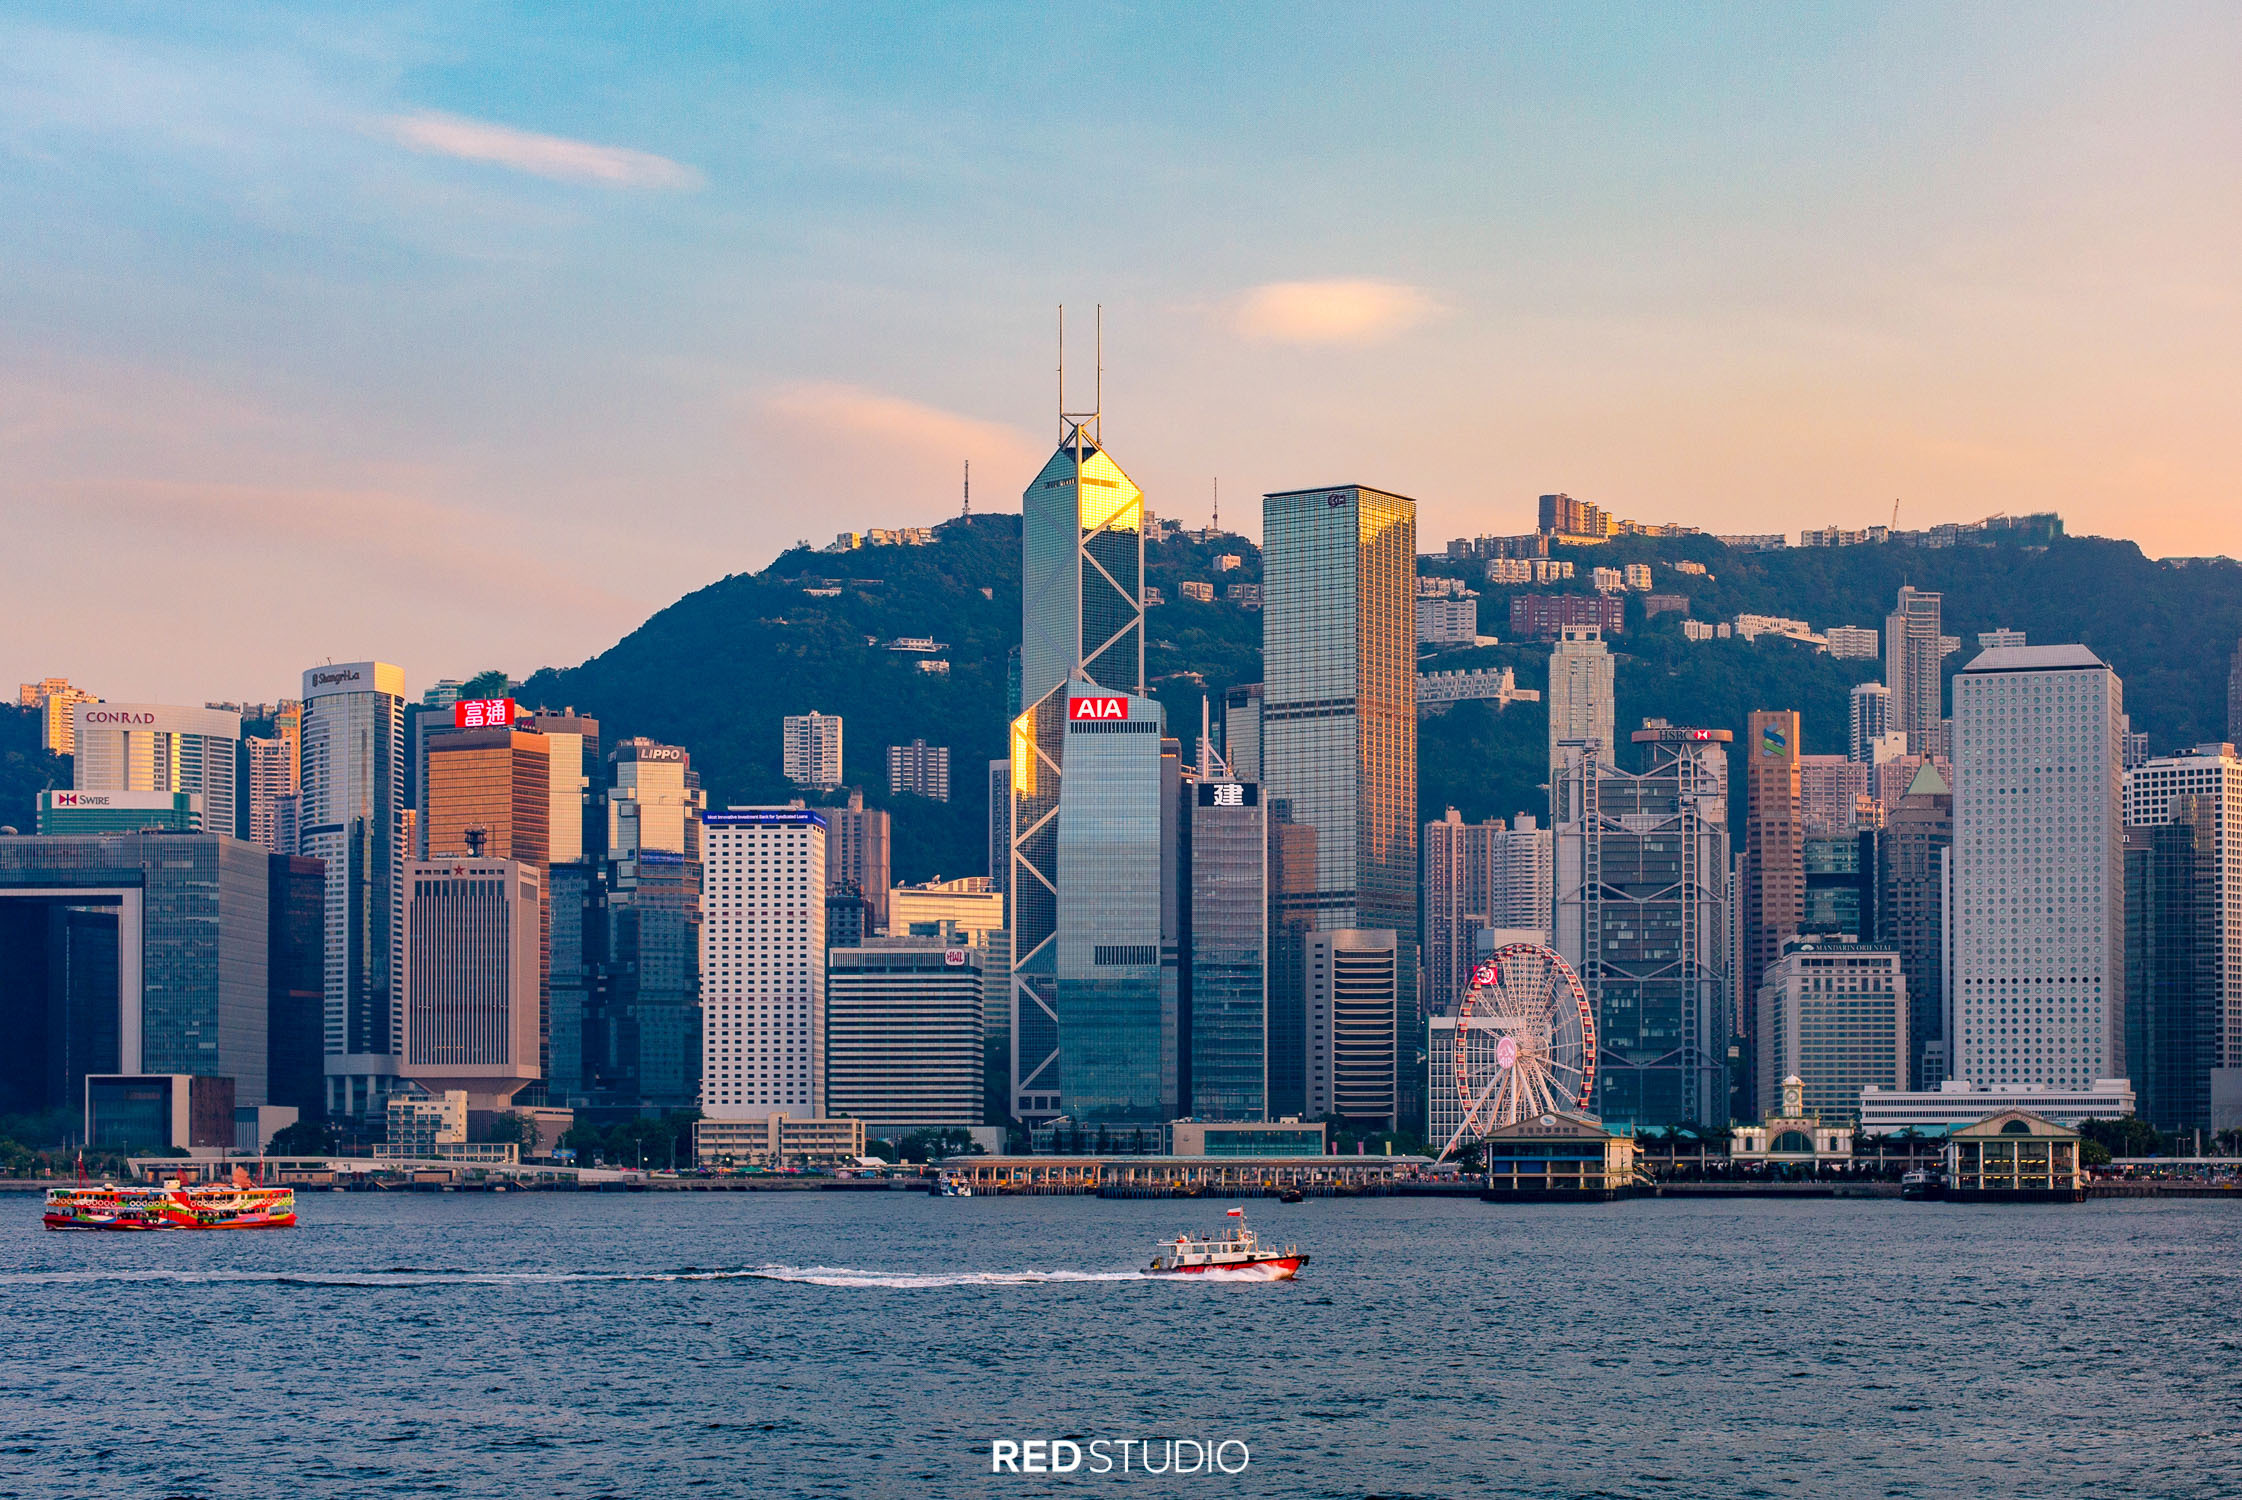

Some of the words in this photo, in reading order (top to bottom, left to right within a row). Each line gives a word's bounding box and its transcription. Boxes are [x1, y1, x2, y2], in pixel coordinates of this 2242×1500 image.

[464, 699, 506, 727] 富通
[1076, 699, 1123, 718] AIA
[86, 711, 155, 724] CONRAD
[1659, 730, 1693, 740] HSBC
[641, 748, 680, 760] LIPPO
[1213, 783, 1244, 806] 建
